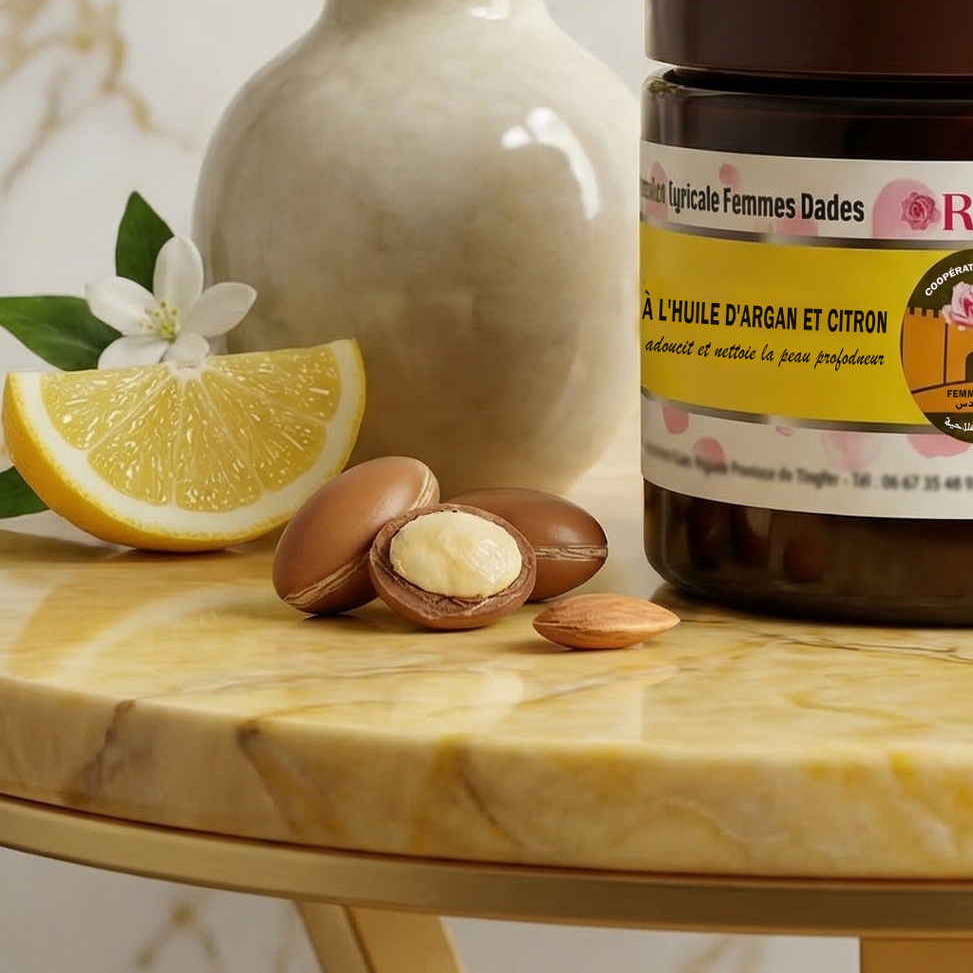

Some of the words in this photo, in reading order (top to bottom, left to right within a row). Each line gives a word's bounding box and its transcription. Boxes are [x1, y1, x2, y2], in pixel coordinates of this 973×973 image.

[723, 187, 796, 218] Femmes
[801, 192, 865, 222] Dades
[642, 290, 653, 320] À
[658, 298, 720, 325] L'HUILE
[725, 303, 797, 330] D'ARGAN
[803, 308, 823, 331] ET
[827, 308, 888, 333] CITRON
[645, 336, 695, 356] adoucit
[697, 341, 712, 357] et
[714, 344, 757, 360] nettoie
[760, 344, 775, 362] la
[778, 348, 811, 367] peau
[814, 348, 885, 371] profodneur
